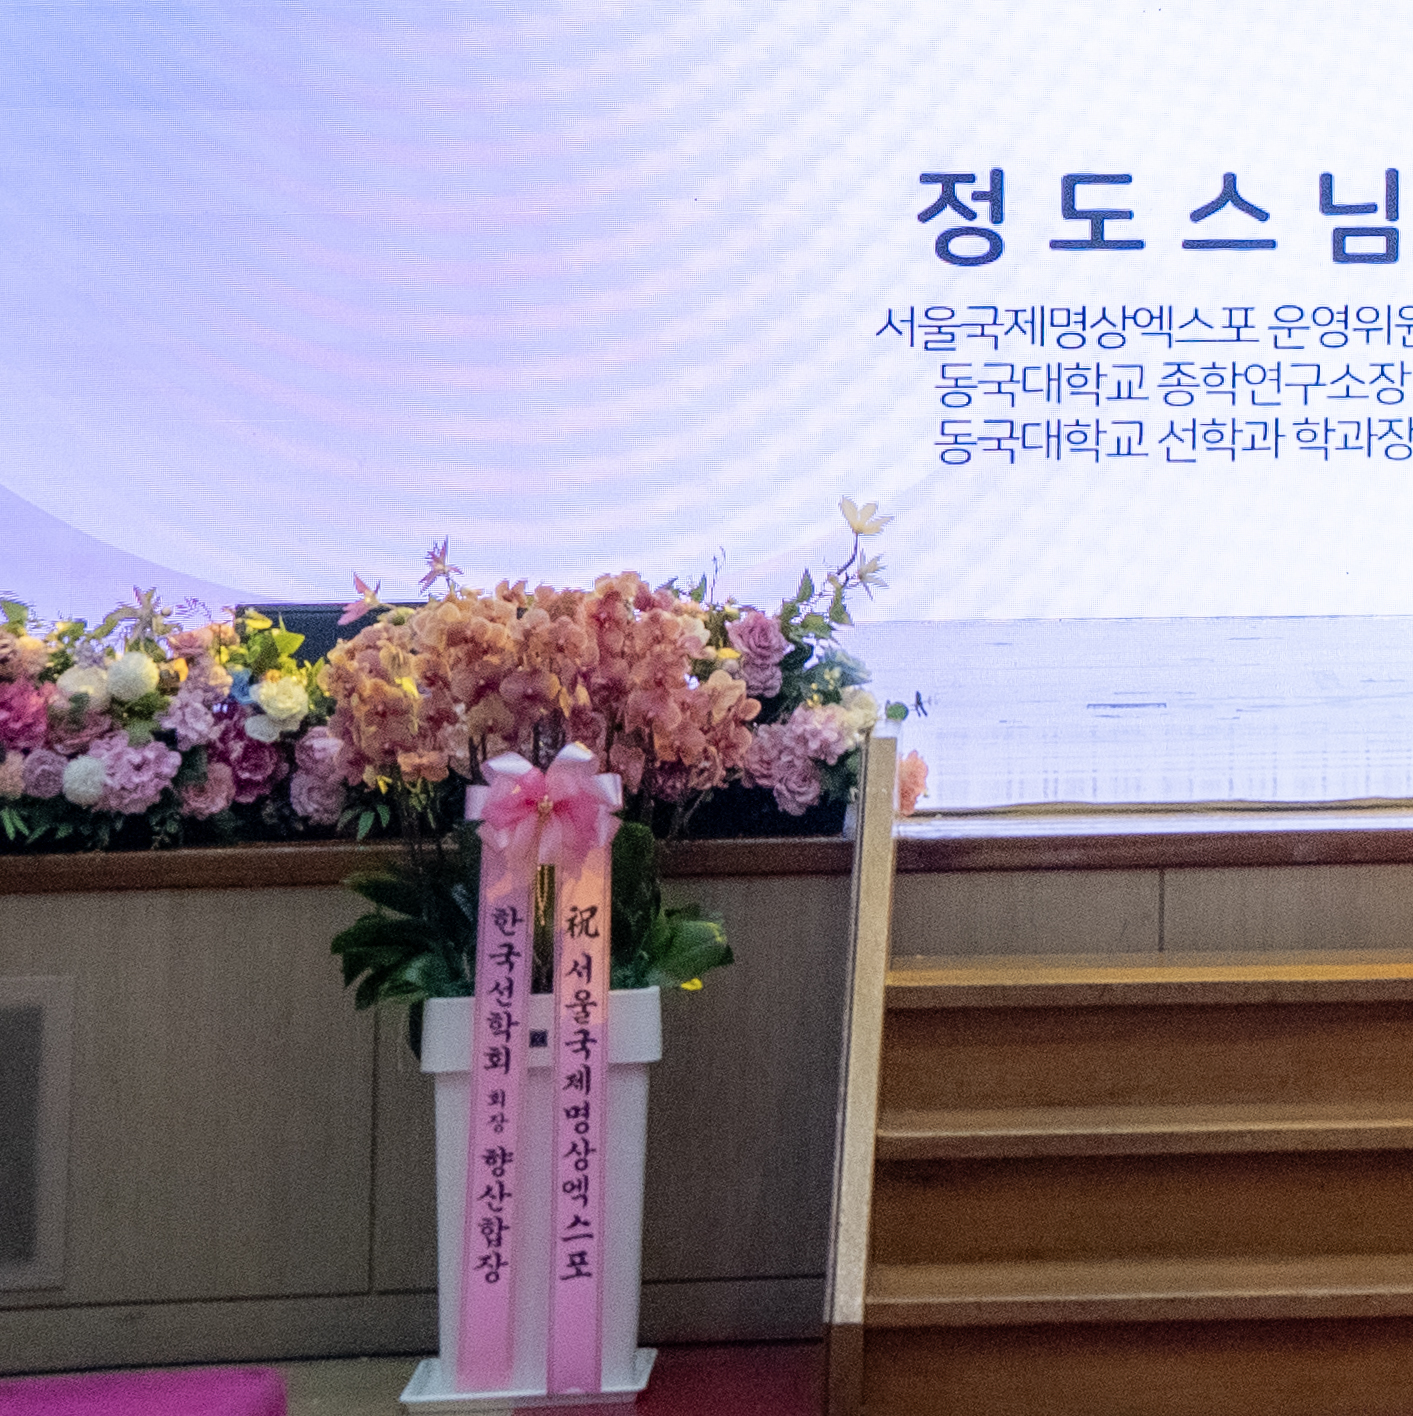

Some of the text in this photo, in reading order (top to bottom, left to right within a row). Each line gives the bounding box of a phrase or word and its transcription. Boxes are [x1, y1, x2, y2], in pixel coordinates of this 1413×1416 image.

[875, 304, 1261, 352] 서울국제명상엑스포
[934, 359, 1413, 409] 동국대학교 종학연구소장
[934, 418, 1149, 466] 동국대학교
[1157, 416, 1286, 464] 선학과
[483, 905, 525, 1075] 한국선학회
[487, 1088, 509, 1134] 회장
[560, 905, 600, 1281] 祝 서울국제명상엑스포
